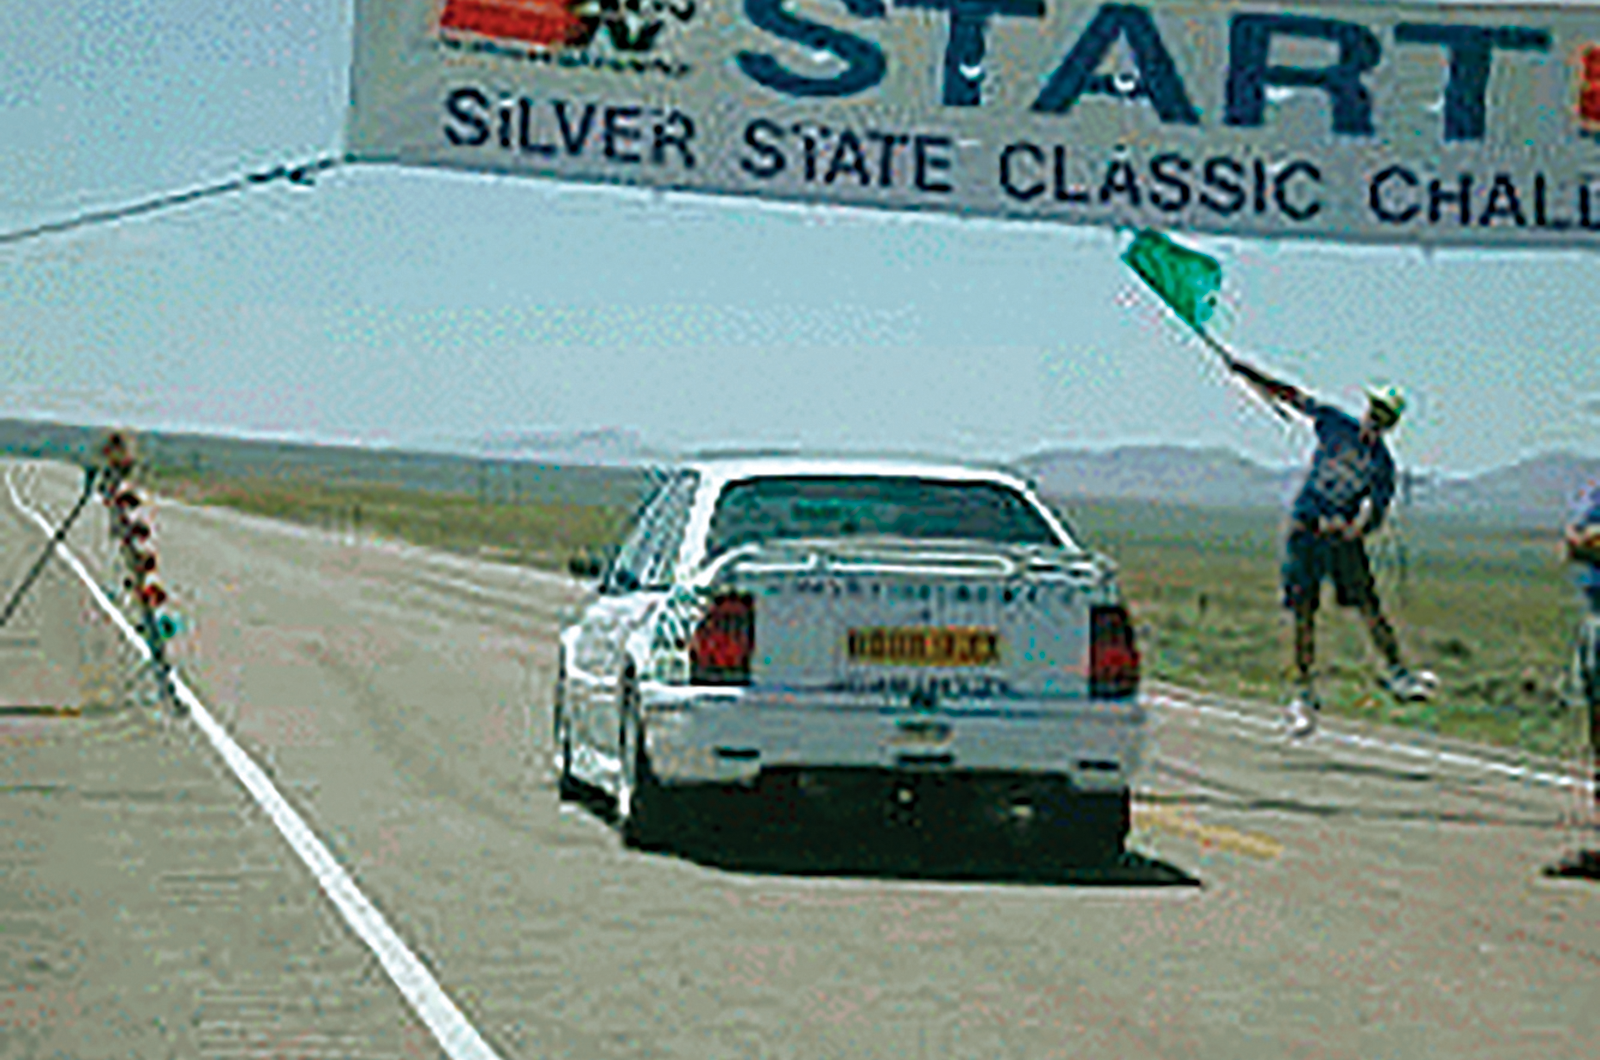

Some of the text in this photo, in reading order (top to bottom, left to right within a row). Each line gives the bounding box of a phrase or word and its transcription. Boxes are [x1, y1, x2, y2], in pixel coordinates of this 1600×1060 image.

[736, 0, 1552, 141] START
[443, 87, 697, 168] SILVER
[741, 119, 953, 192] STATE
[1000, 142, 1322, 220] CLASSIC
